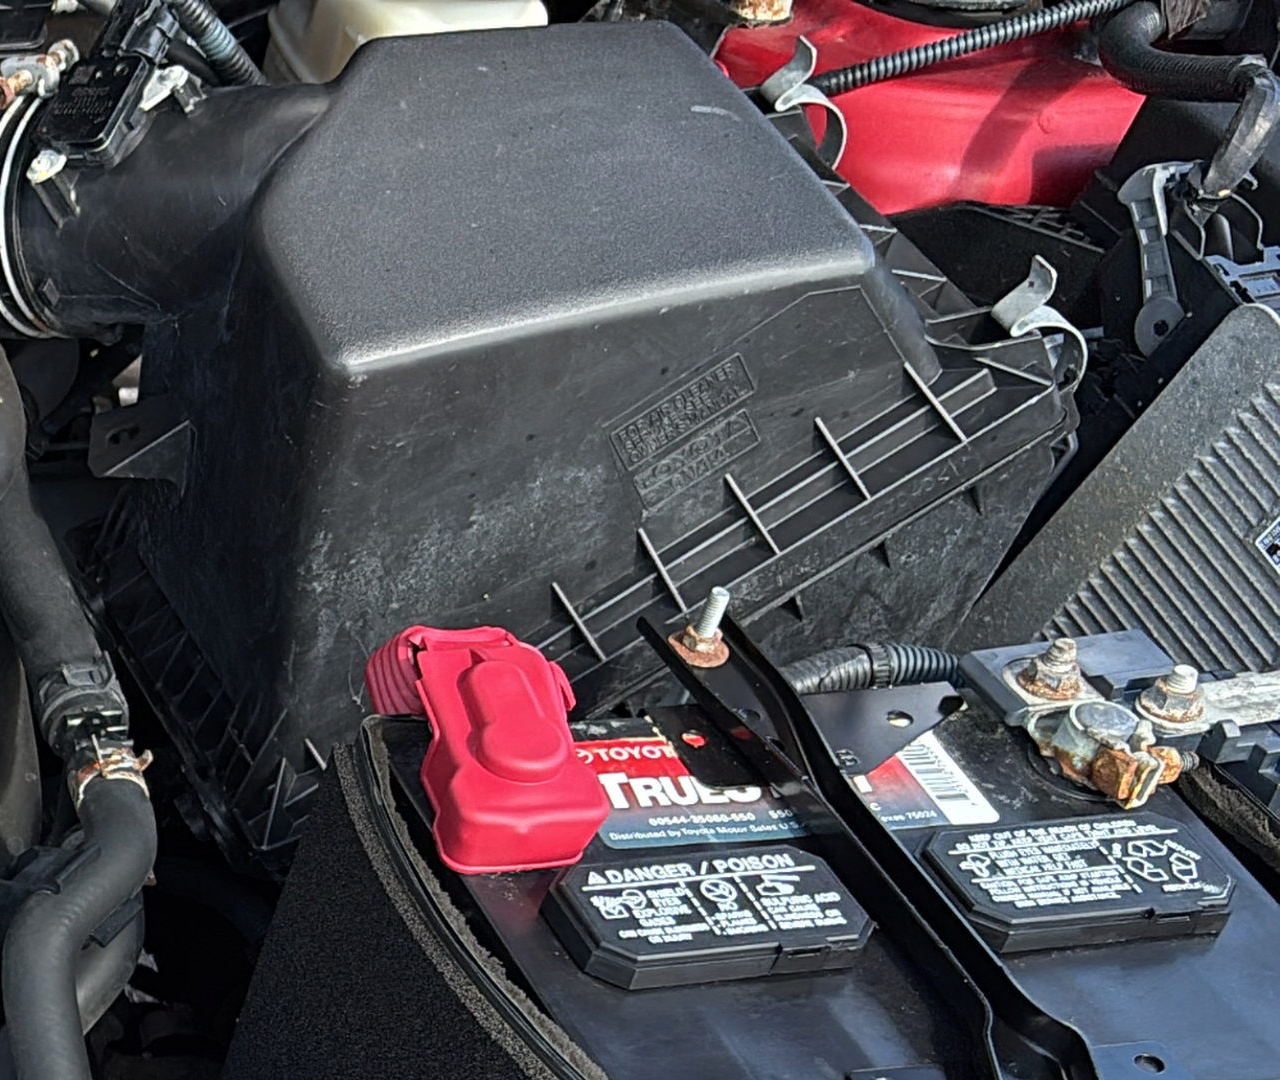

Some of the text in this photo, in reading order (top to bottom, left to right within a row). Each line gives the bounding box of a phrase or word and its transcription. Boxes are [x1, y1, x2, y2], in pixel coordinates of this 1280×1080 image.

[597, 745, 679, 763] TOYOT
[608, 829, 667, 841] Distributed
[667, 828, 681, 838] by
[680, 825, 716, 838] Toyota
[716, 824, 748, 834] Motor
[749, 821, 779, 833] Sales
[604, 862, 696, 883] DANGER
[712, 852, 795, 874] POISON
